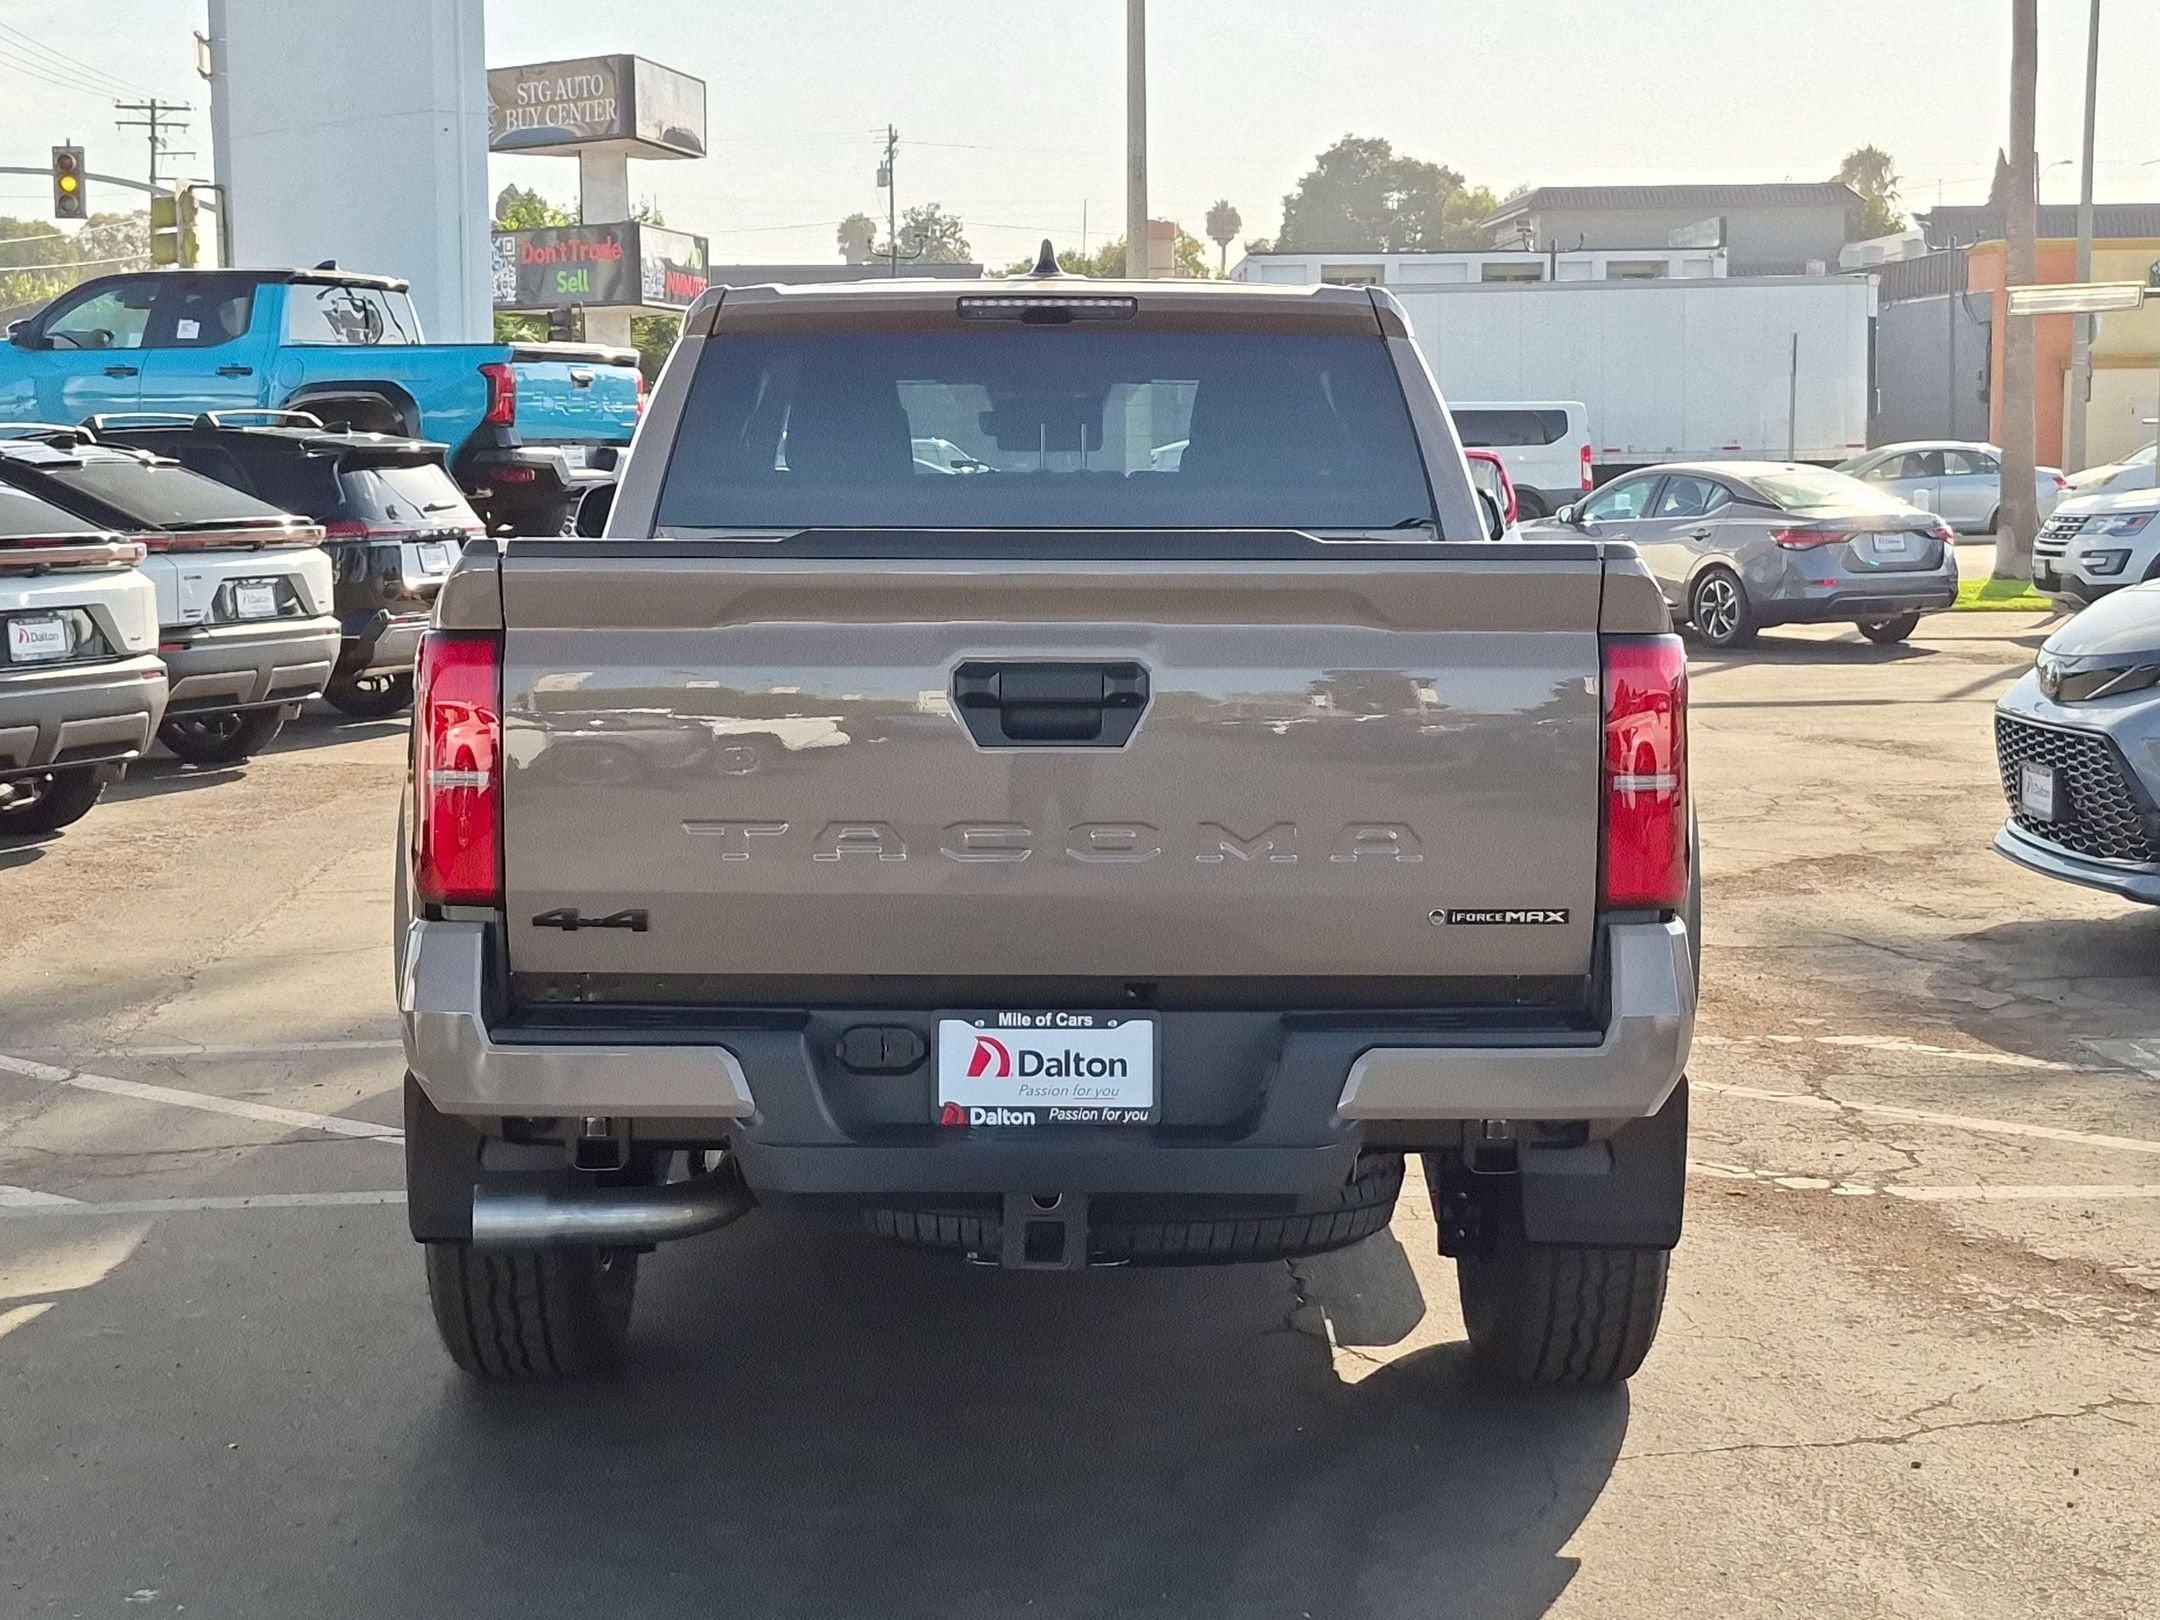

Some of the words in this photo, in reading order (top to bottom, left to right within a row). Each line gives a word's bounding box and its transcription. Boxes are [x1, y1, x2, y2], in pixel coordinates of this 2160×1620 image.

[517, 80, 551, 105] STG
[556, 74, 604, 100] AUTO
[505, 106, 541, 131] BUY
[545, 98, 617, 126] CENTER
[521, 240, 567, 265] Don't
[568, 236, 624, 262] Trade
[557, 269, 590, 294] Sell
[682, 820, 1425, 864] TACOMA
[998, 1012, 1032, 1027] Mile
[1035, 1012, 1053, 1027] of
[1055, 1012, 1094, 1027] Cars
[1018, 1049, 1128, 1078] Dalton
[1018, 1084, 1069, 1097] Passion
[1072, 1084, 1093, 1097] for
[1094, 1087, 1120, 1098] you
[970, 1108, 1036, 1126] Dalton
[1049, 1108, 1099, 1122] Passion
[1101, 1107, 1122, 1122] for
[1123, 1111, 1149, 1123] you
